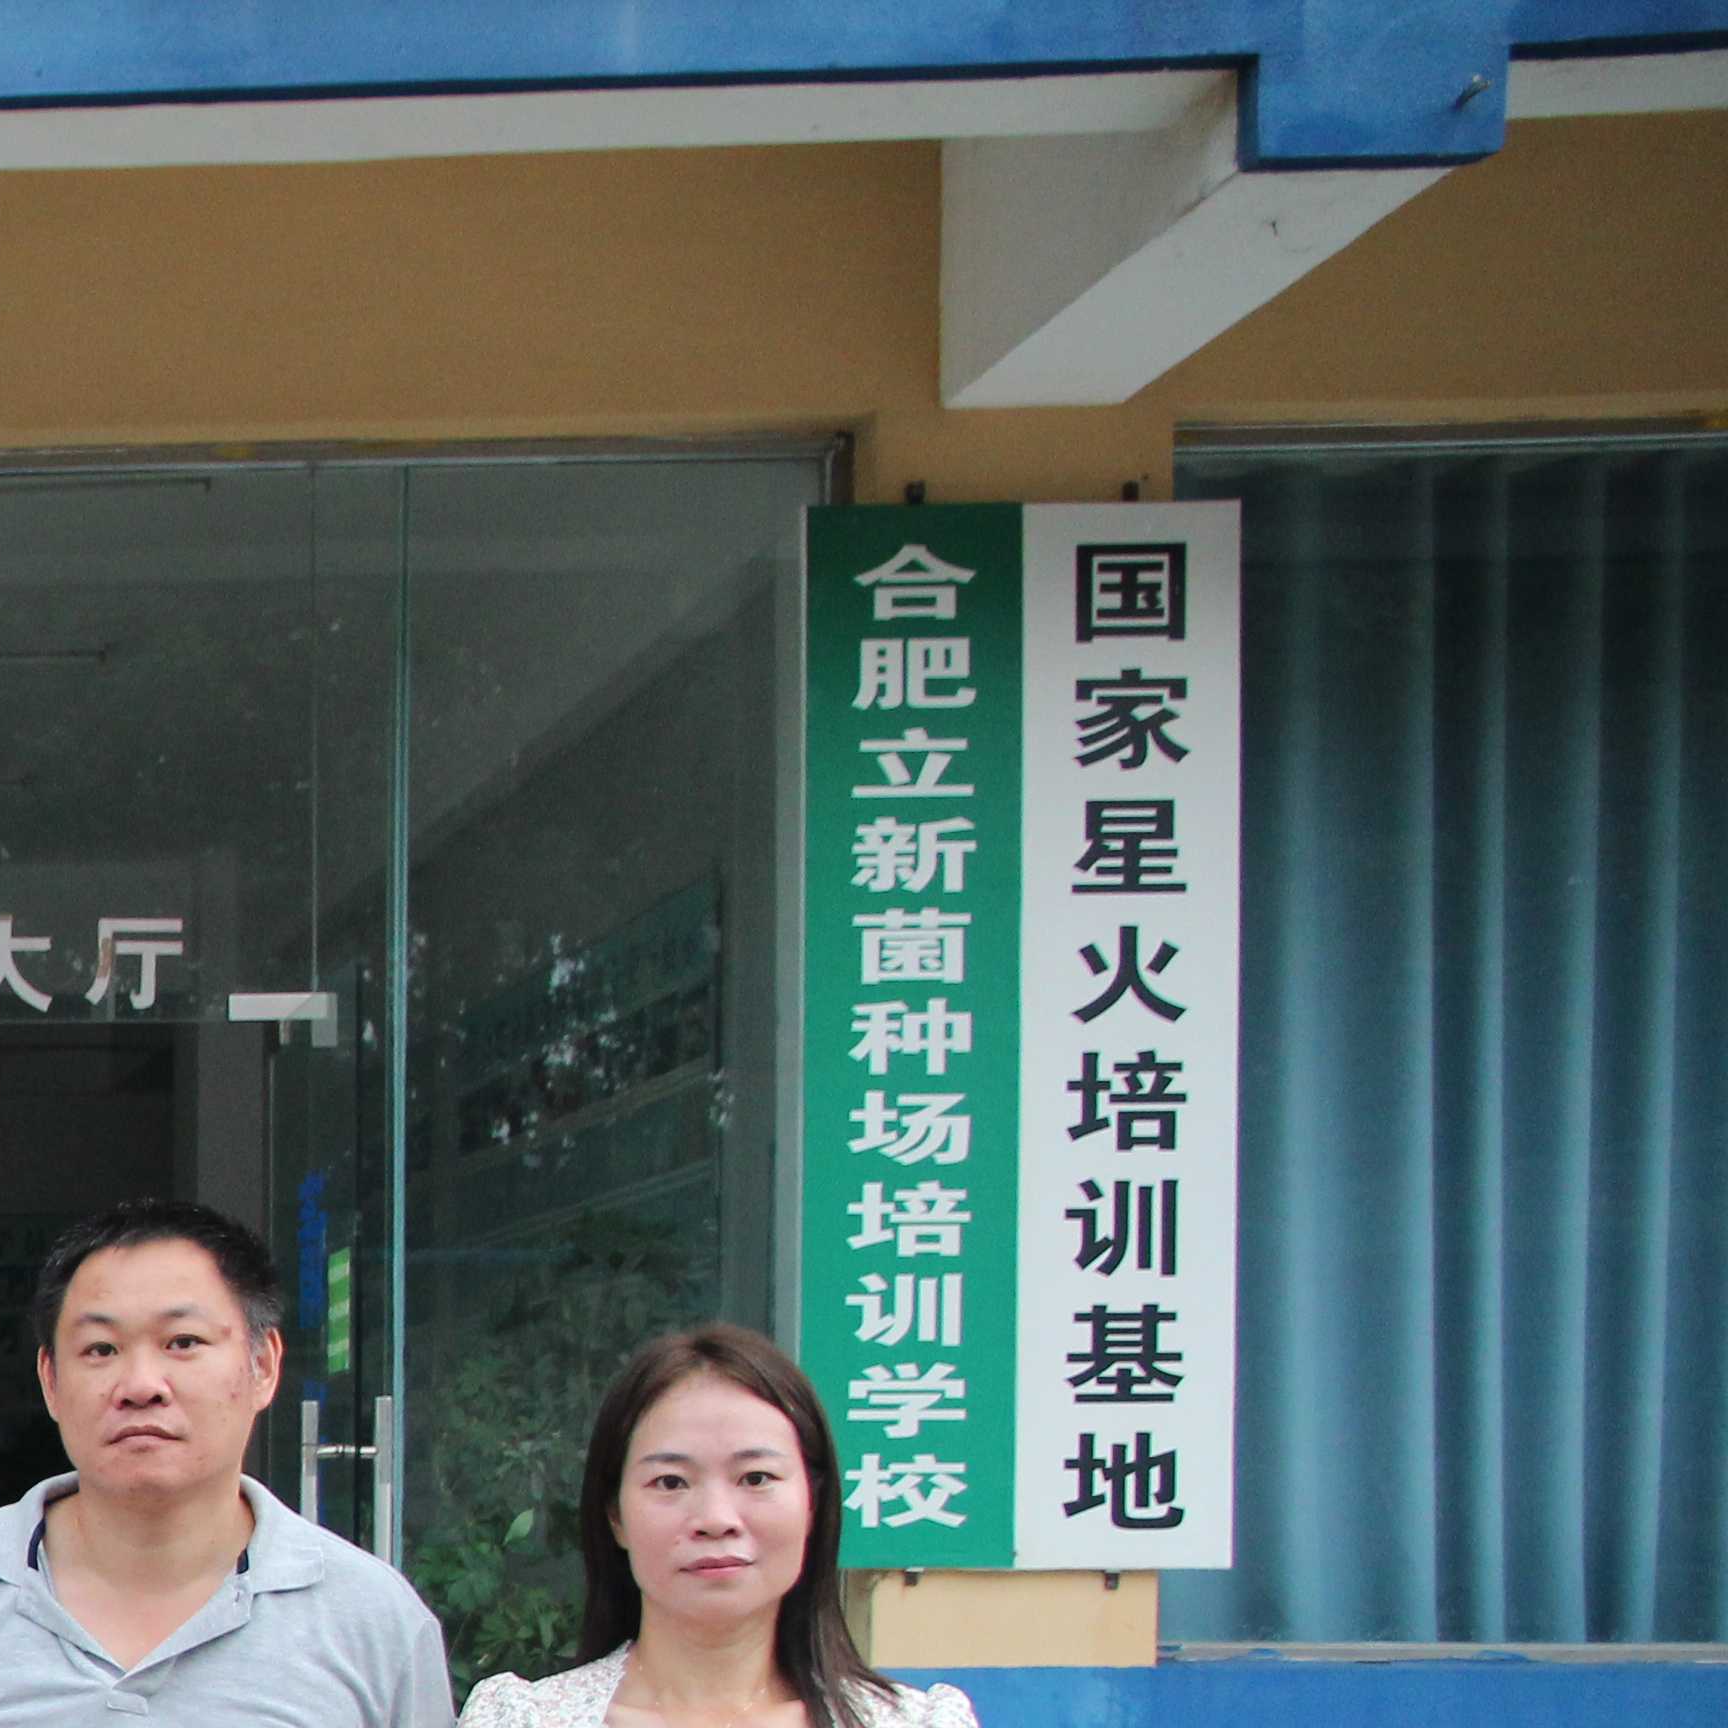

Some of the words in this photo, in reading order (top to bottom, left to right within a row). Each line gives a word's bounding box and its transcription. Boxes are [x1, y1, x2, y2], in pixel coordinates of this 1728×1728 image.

[843, 543, 978, 1529] 合肥立新菌种场培训学校
[1063, 541, 1190, 1529] 国家星火培训基地
